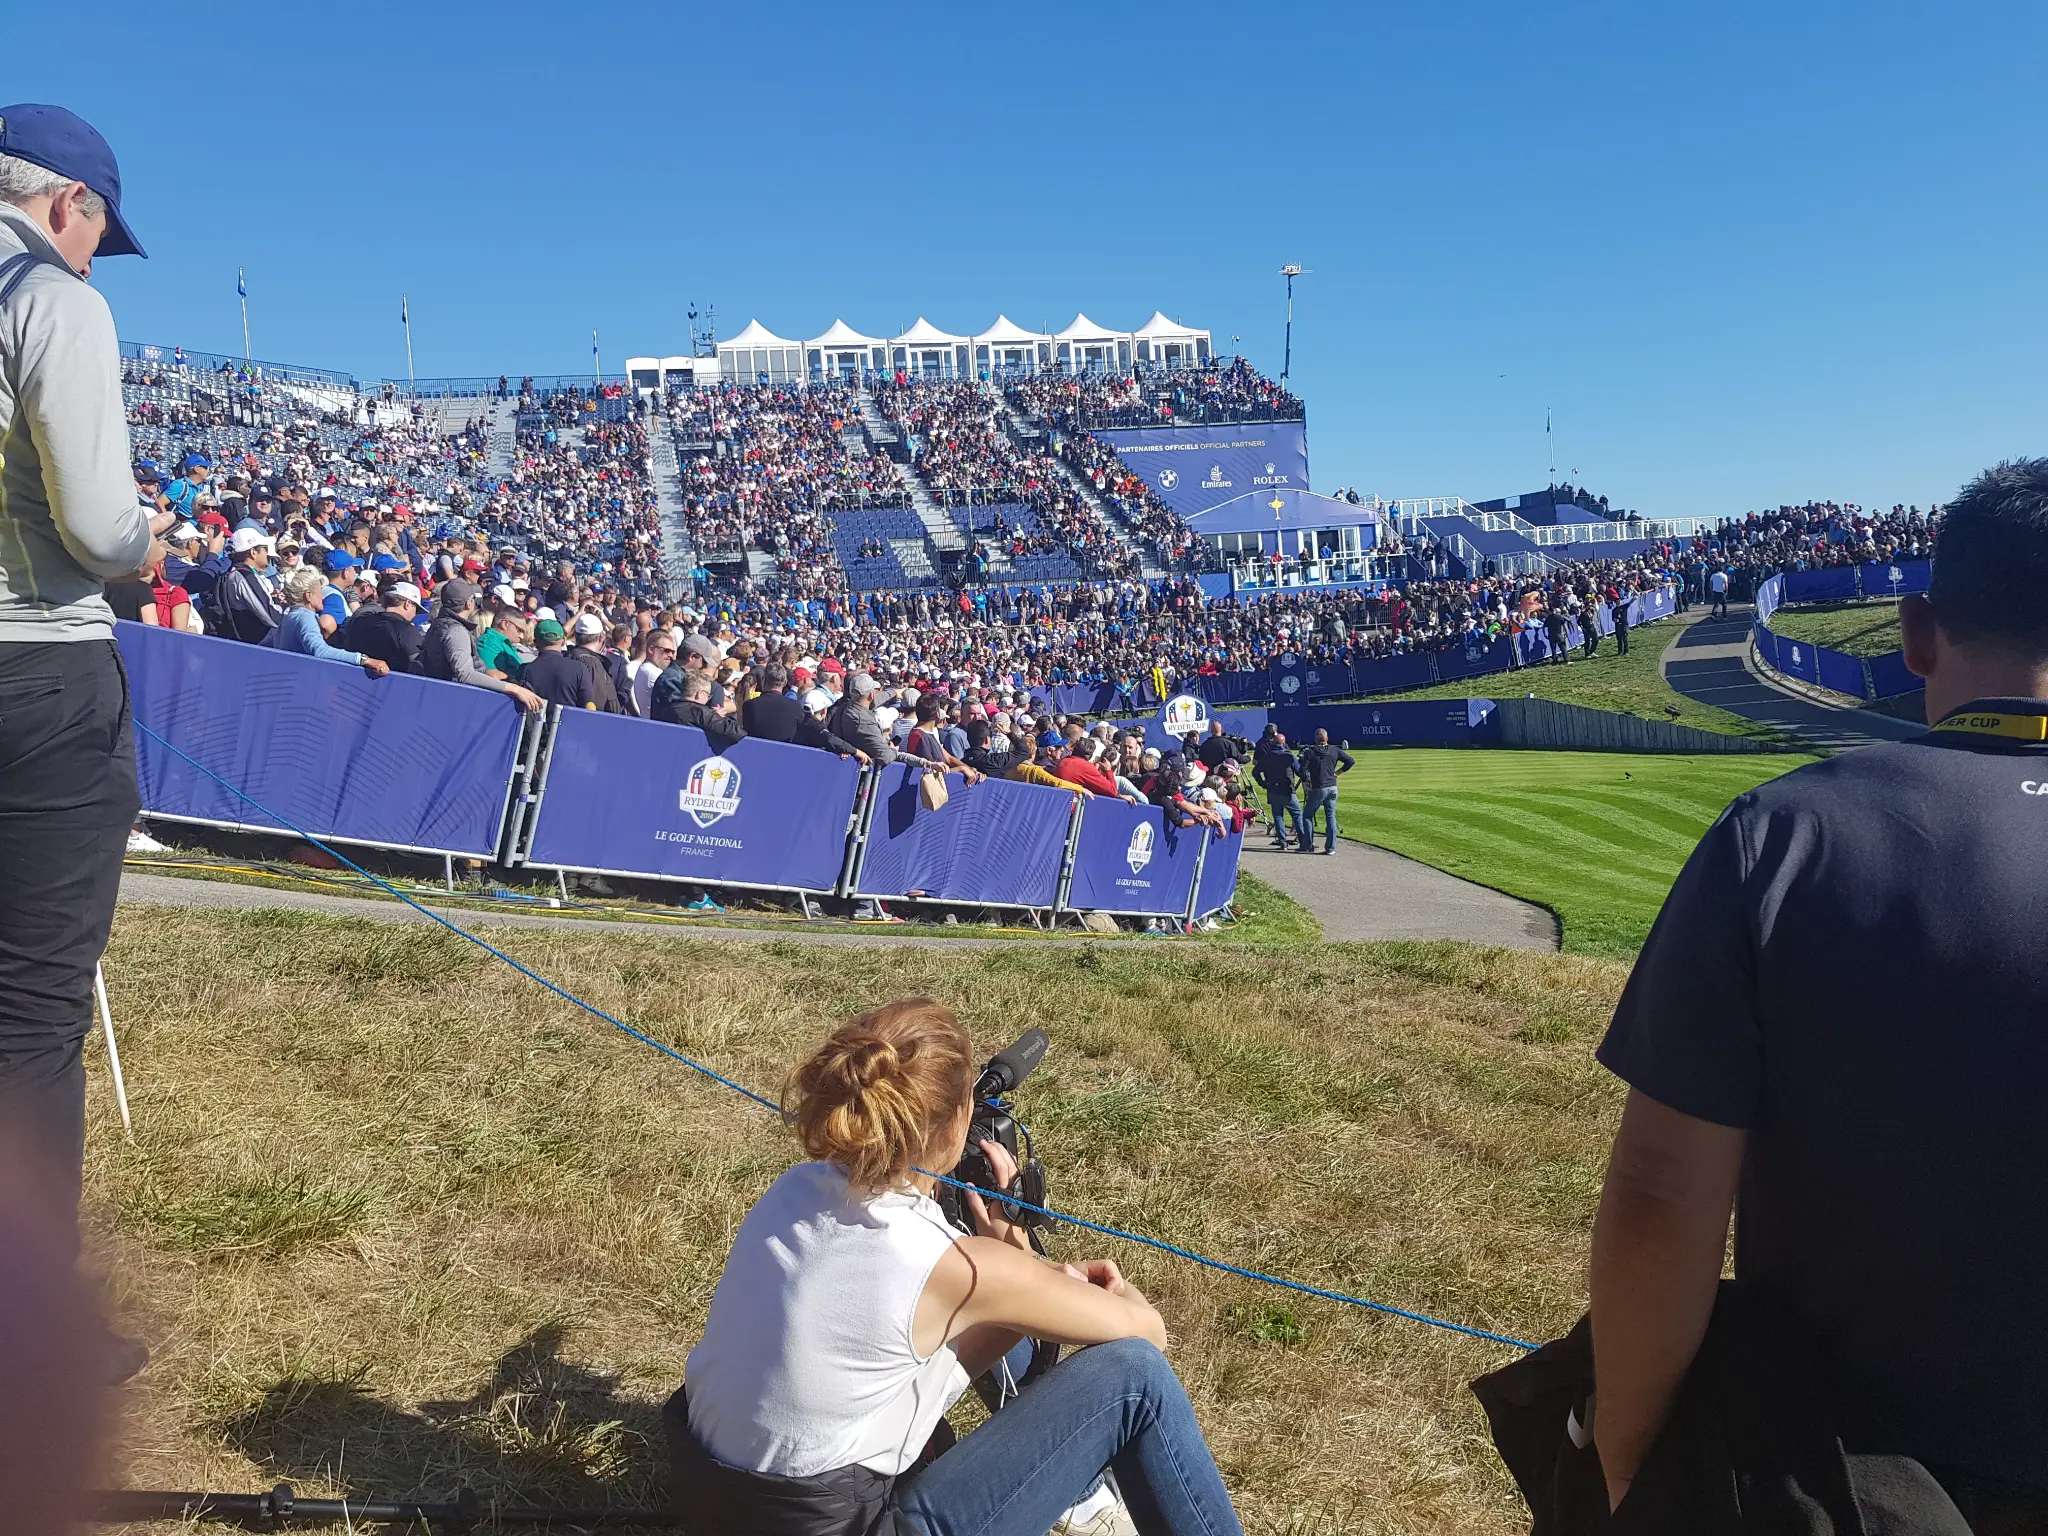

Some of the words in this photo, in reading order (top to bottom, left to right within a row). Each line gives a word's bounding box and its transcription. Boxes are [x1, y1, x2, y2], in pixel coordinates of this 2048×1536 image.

[1117, 445, 1164, 453] PARTENAIRES
[1164, 443, 1199, 451] OFFICIELS
[1231, 440, 1266, 448] PARTNERS
[1201, 480, 1232, 489] Emirates
[1253, 475, 1289, 485] ROLEX
[1480, 709, 1487, 725] 1
[1970, 717, 2000, 728] CUP
[1362, 725, 1392, 735] ROLEX
[683, 796, 715, 808] RYDER
[715, 800, 735, 811] CUP
[699, 812, 714, 820] 2018
[655, 830, 668, 841] LE
[669, 832, 695, 844] GOLF
[695, 835, 744, 849] NATIONAL
[680, 846, 715, 858] FRANCE
